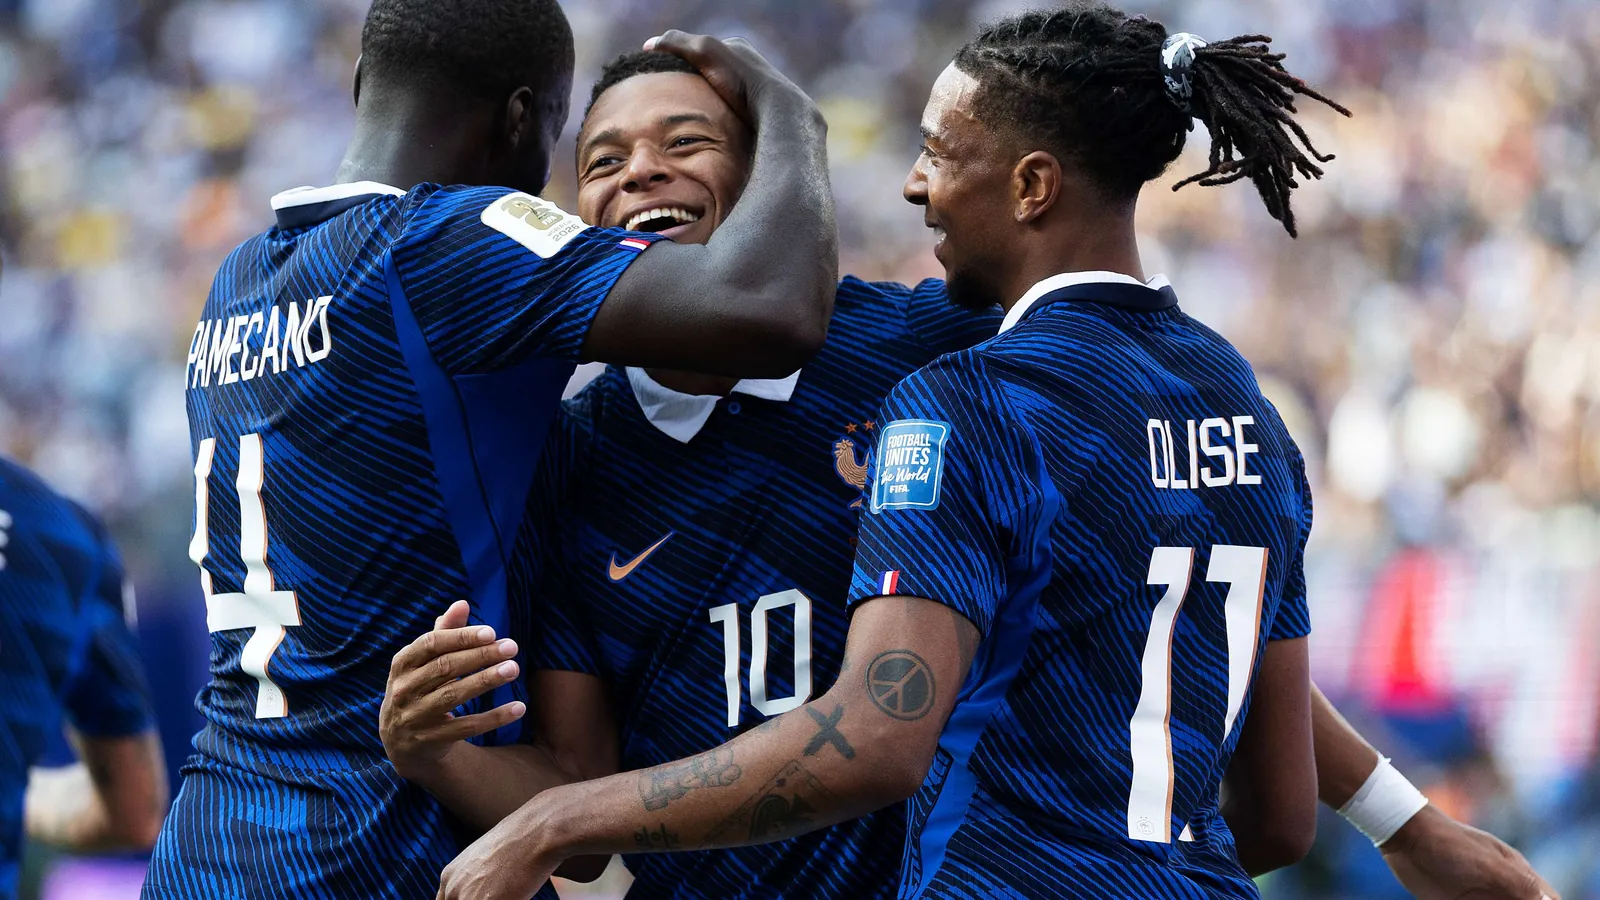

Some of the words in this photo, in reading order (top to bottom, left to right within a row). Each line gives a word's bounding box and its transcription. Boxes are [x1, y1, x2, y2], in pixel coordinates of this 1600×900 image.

[541, 215, 557, 225] FIFA
[552, 223, 580, 242] 2026
[185, 295, 333, 390] PAMECANO
[887, 433, 931, 449] FOOTBALL
[884, 447, 931, 467] UNITES
[1147, 415, 1262, 489] OLISE
[881, 467, 895, 485] the
[895, 466, 931, 483] World
[889, 484, 909, 493] FIFA
[188, 432, 303, 719] 4
[708, 588, 813, 728] 10
[1127, 544, 1269, 844] 11
